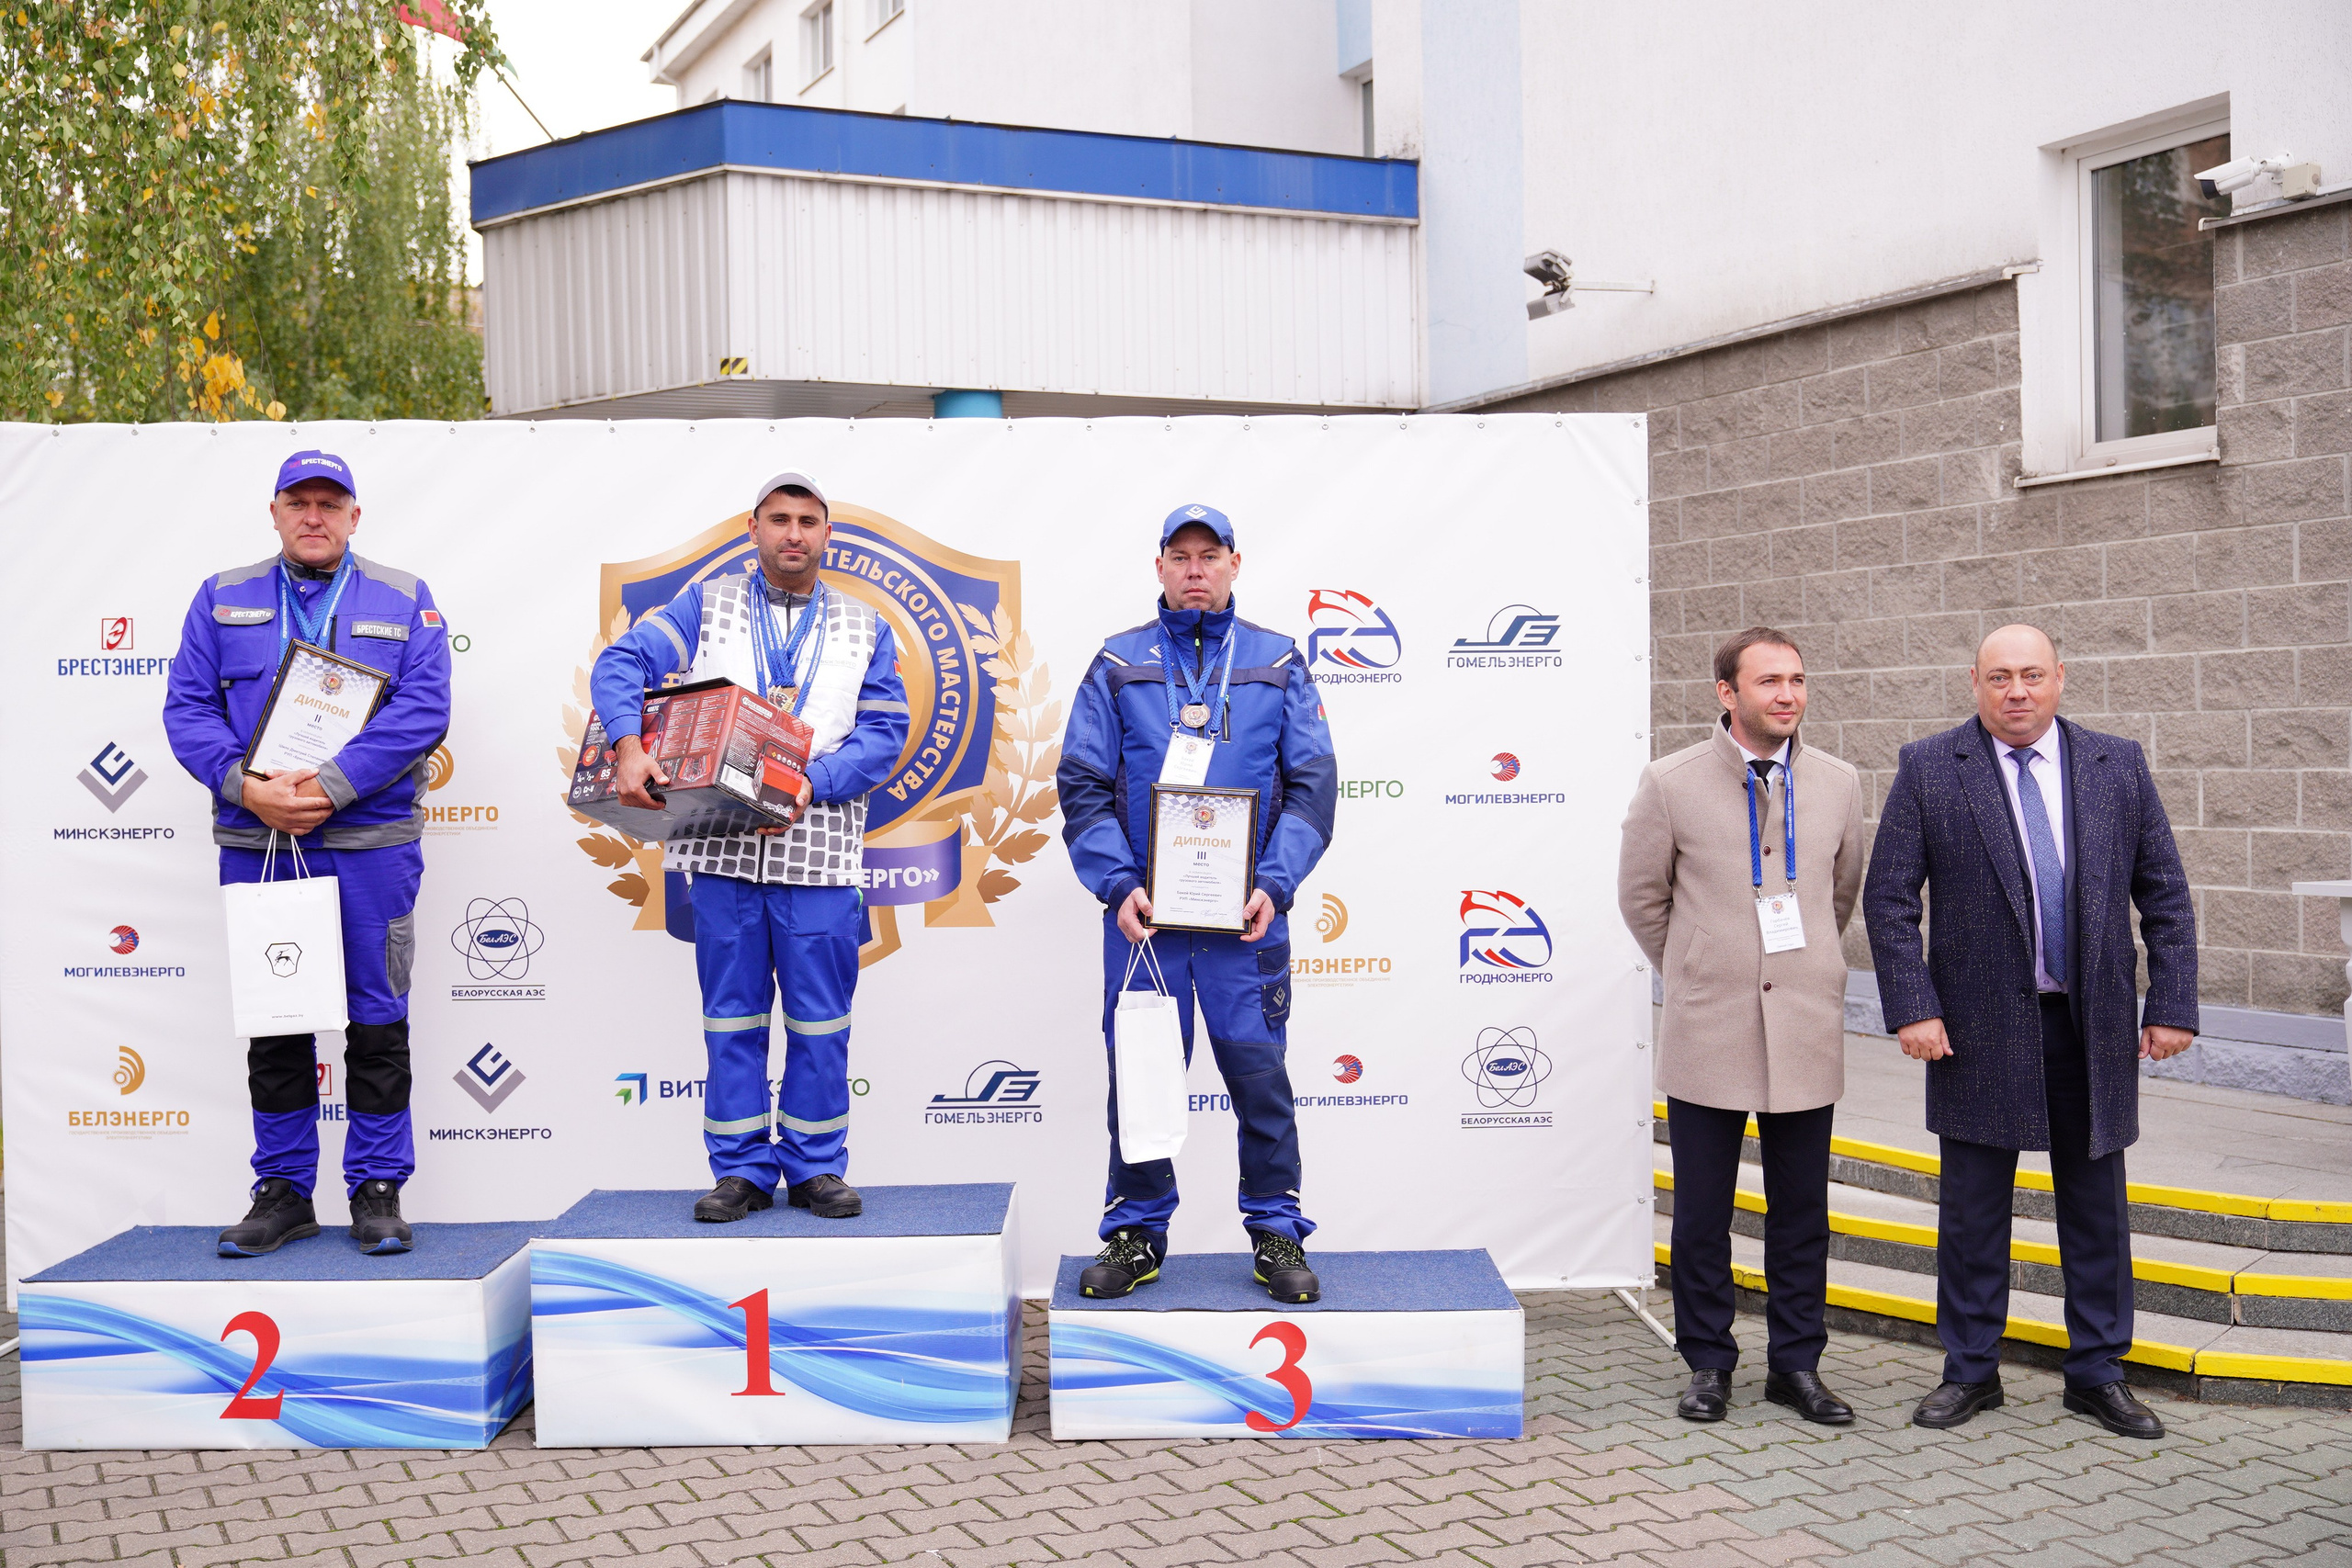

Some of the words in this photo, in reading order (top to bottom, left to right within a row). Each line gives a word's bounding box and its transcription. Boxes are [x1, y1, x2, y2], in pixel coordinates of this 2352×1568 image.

[301, 457, 343, 472] БРЕСТЭНЕРГО
[356, 625, 392, 637] БРЕСТСКИЕ
[394, 627, 401, 637] ТС
[1447, 656, 1563, 668] ГОМЕЛЬЭНЕРГО
[294, 694, 350, 719] ДИПЛОМ
[314, 714, 322, 722] II
[307, 723, 322, 731] место
[887, 647, 961, 802] МАСТЕРСТВА
[600, 768, 612, 778] 85
[1445, 793, 1566, 805] МОГИЛЕВЭНЕРГО
[53, 828, 175, 840] МИНСКЭНЕРГО
[1172, 835, 1231, 849] ДИПЛОМ
[1196, 851, 1206, 860] III
[479, 933, 517, 943] БелАЭС
[64, 966, 186, 977] МОГИЛЕВЭНЕРГО
[1460, 973, 1553, 985] ГРОДНОЭНЕРГО
[526, 988, 546, 997] АЭС
[1488, 1062, 1525, 1072] БелАЭС
[68, 1111, 189, 1126] БЕЛЭНЕРГО
[925, 1111, 1043, 1124] ГОМЕЛЬЭНЕРГО
[1461, 1117, 1531, 1125] БЕЛОРУССКАЯ
[429, 1128, 552, 1140] МИНСКЭНЕРГО
[727, 1288, 786, 1396] 1
[220, 1311, 285, 1420] 2
[1244, 1320, 1313, 1433] 3
